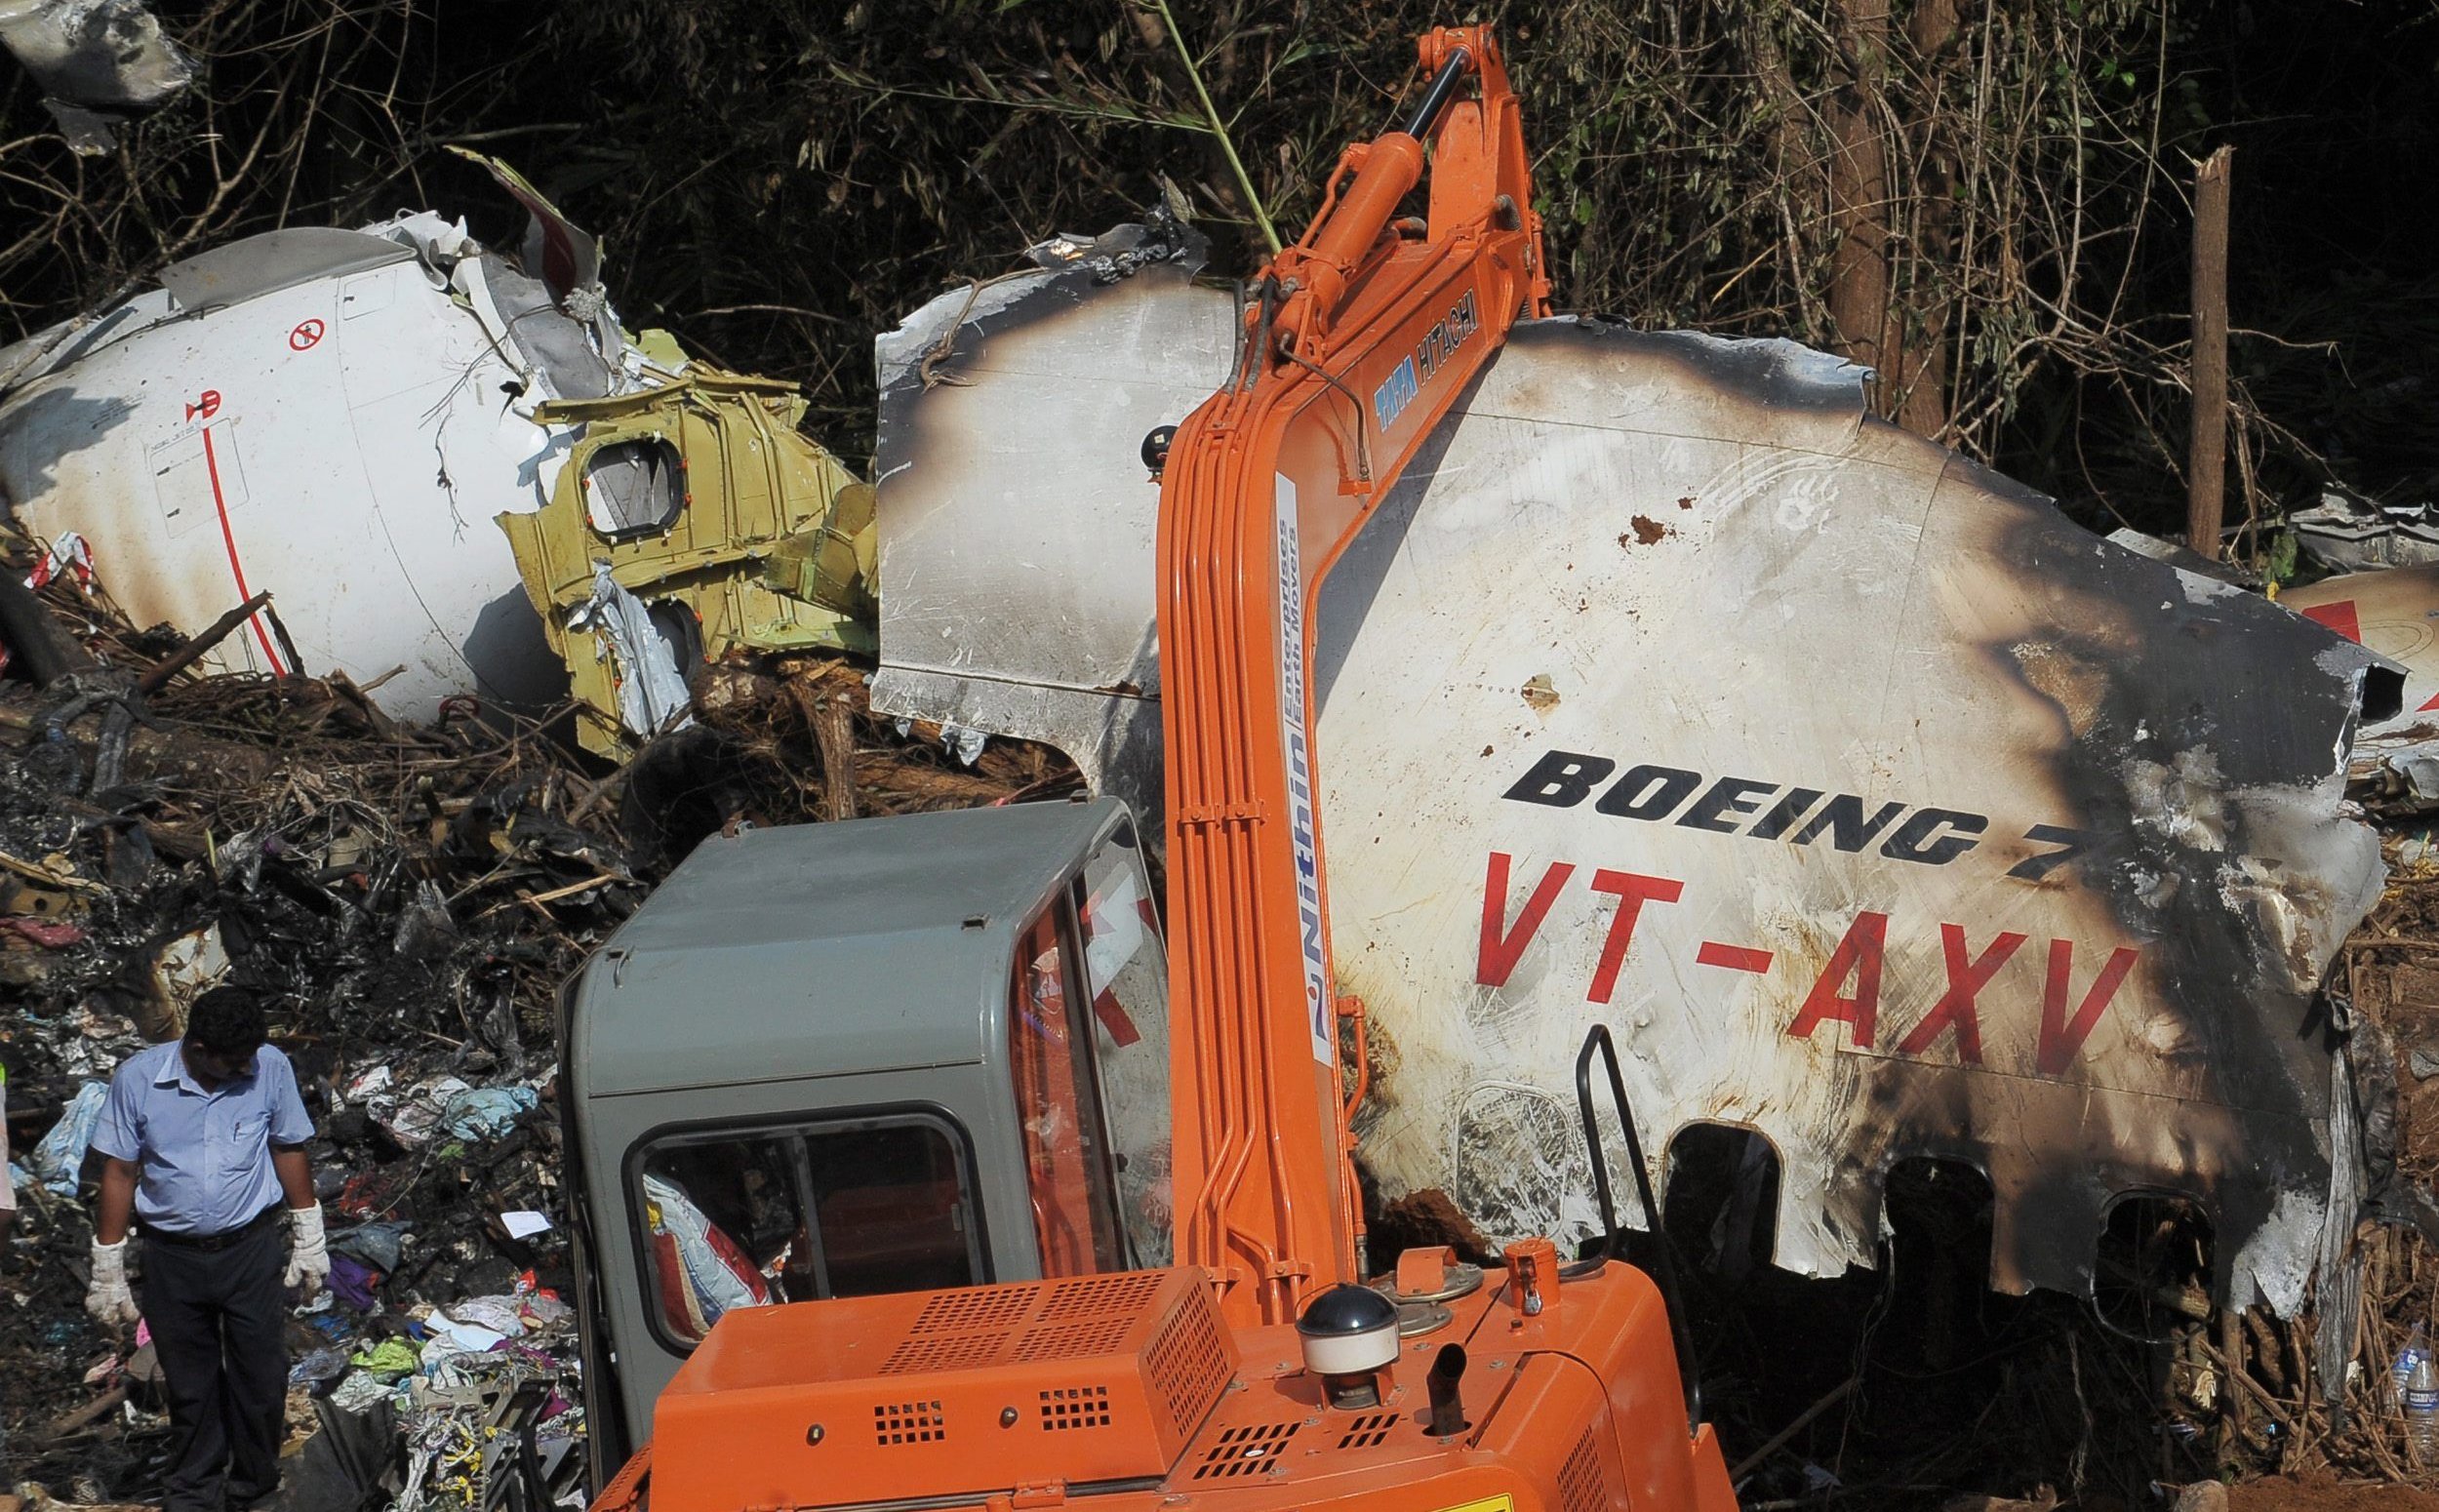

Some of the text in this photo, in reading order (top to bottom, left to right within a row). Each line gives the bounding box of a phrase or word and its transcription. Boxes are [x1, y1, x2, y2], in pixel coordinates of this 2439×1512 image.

[1374, 288, 1478, 433] TATA HITACHI
[1279, 519, 1293, 718] Enterprises
[1288, 527, 1302, 724] Earth Movers
[1290, 734, 1322, 964] Nithin
[1500, 749, 2082, 881] BOEING 7
[1476, 851, 2139, 1073] VT-AXV
